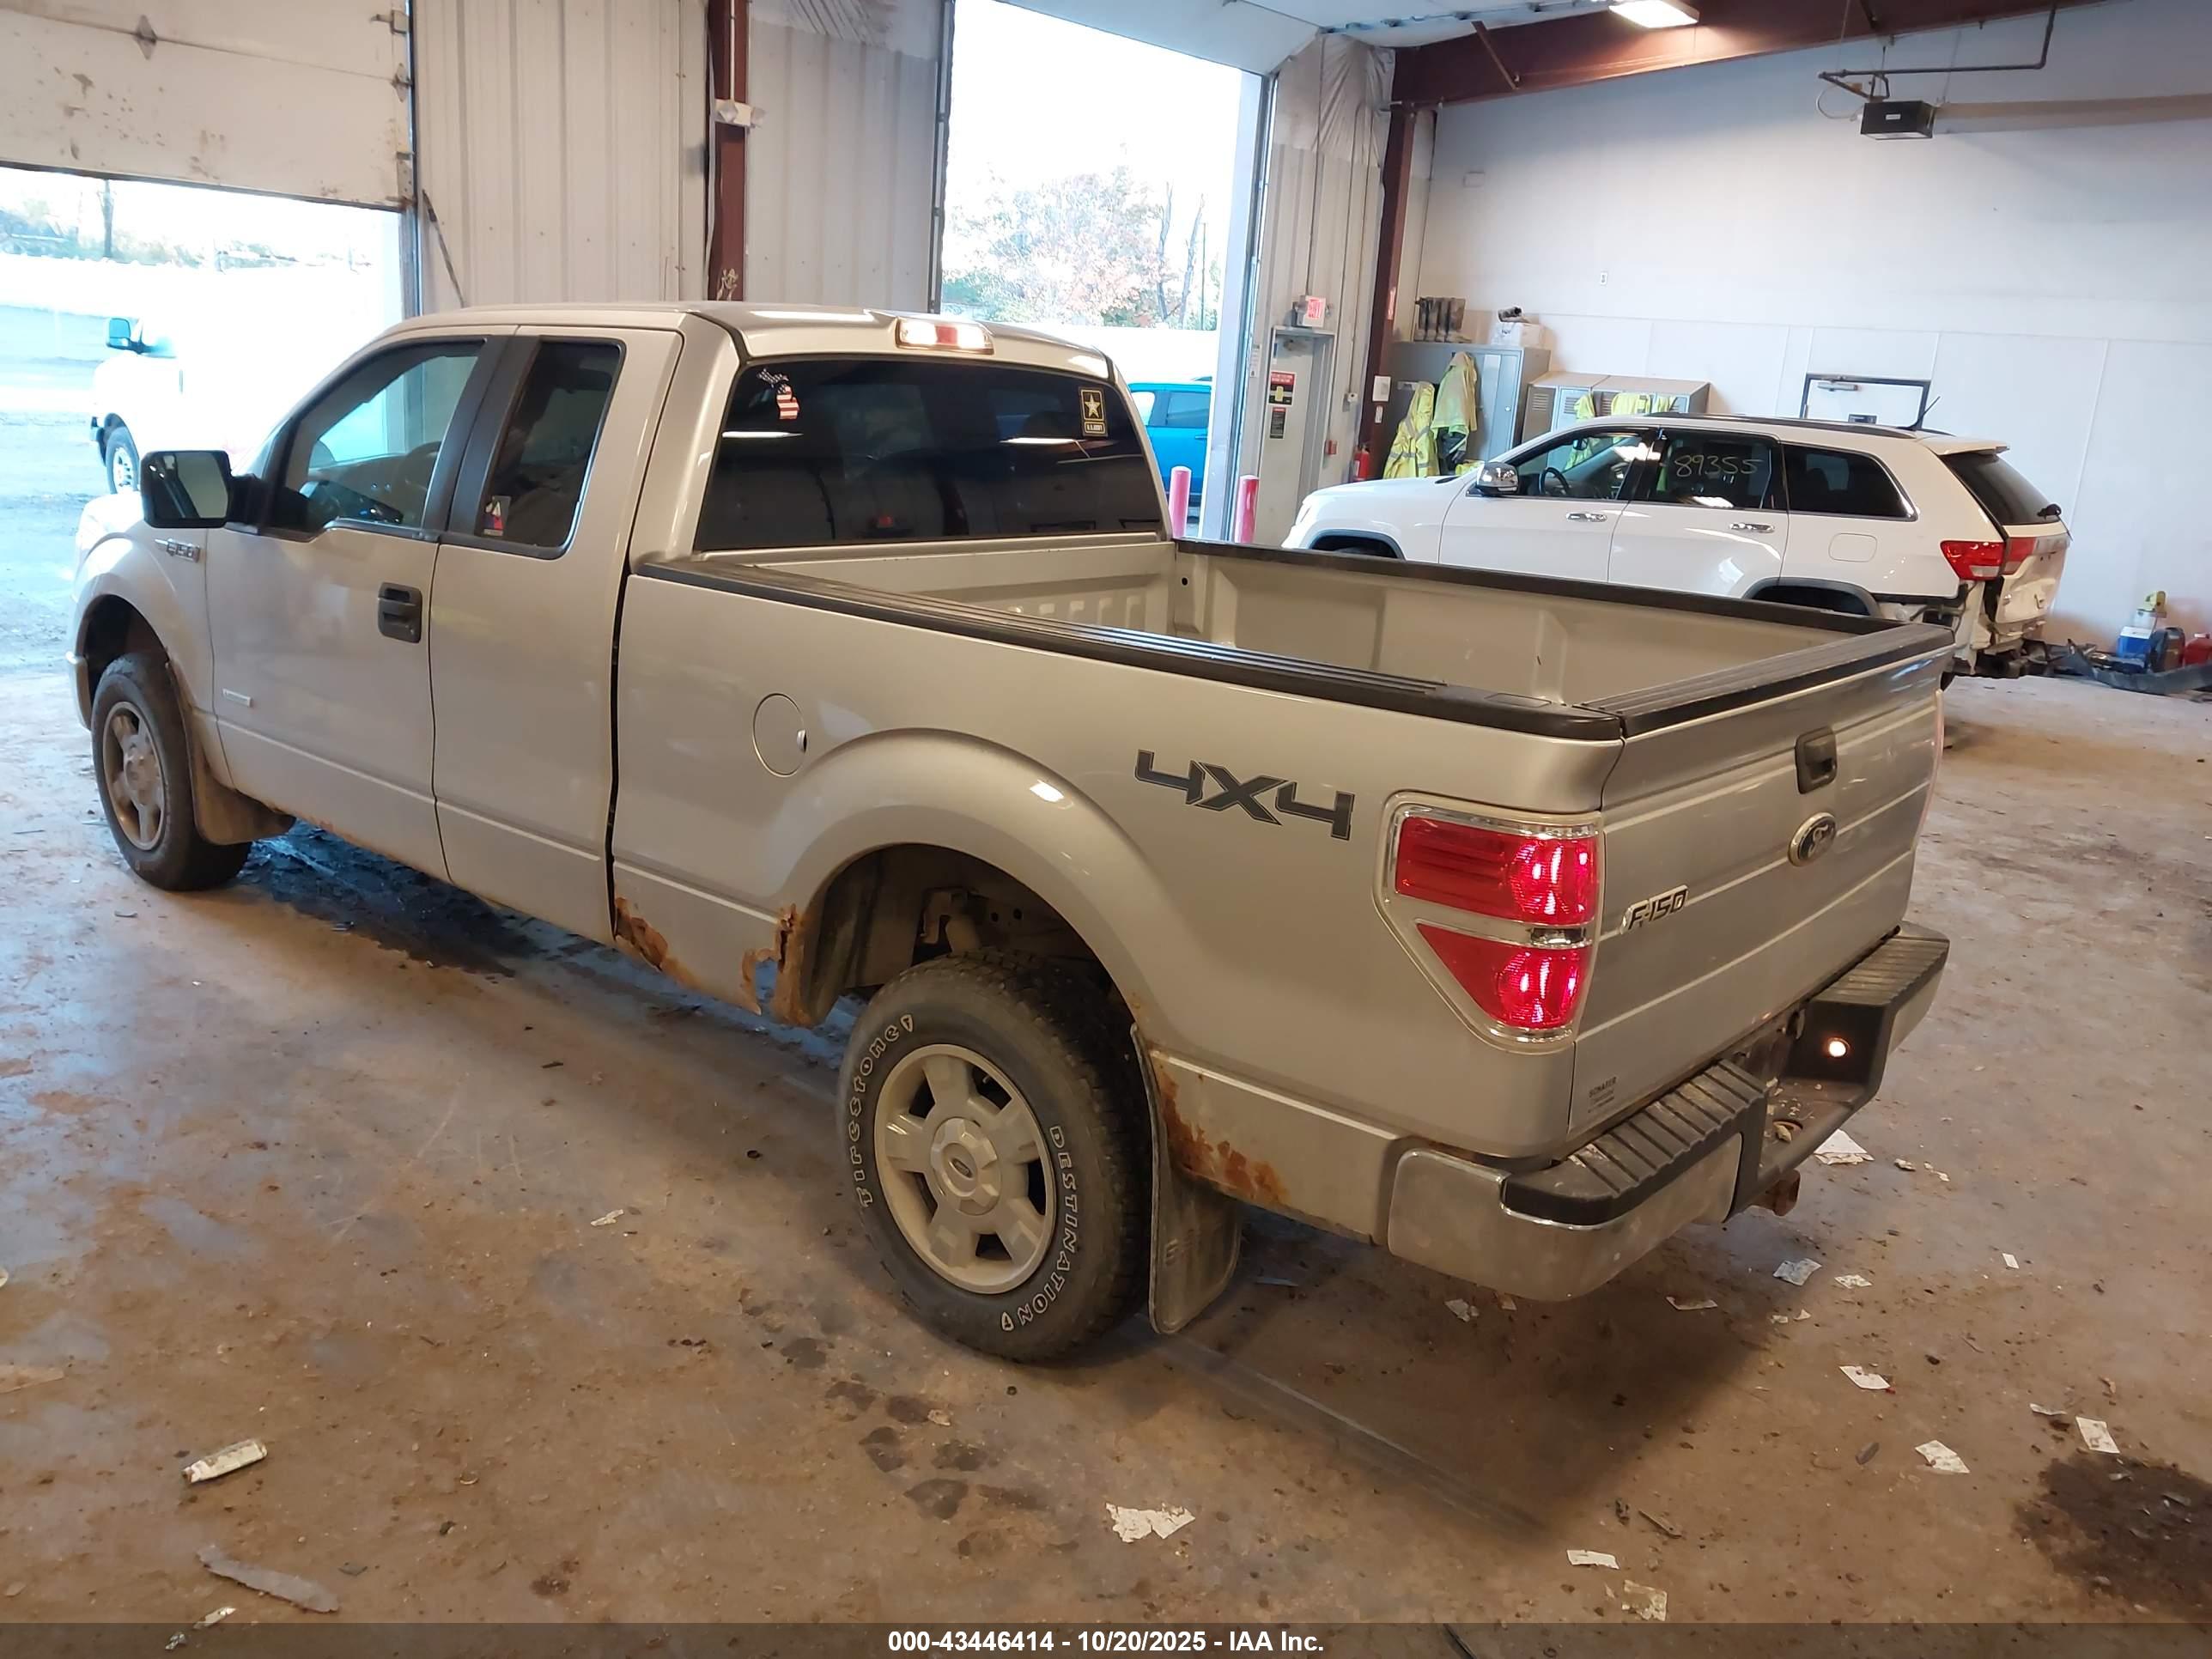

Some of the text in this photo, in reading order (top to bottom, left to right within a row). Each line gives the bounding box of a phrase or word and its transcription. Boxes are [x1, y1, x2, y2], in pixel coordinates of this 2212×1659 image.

[1674, 454, 1765, 477] 89355
[1134, 749, 1356, 842] 4X4
[1626, 885, 1688, 931] F-150
[1017, 1126, 1079, 1326] DESTINATION
